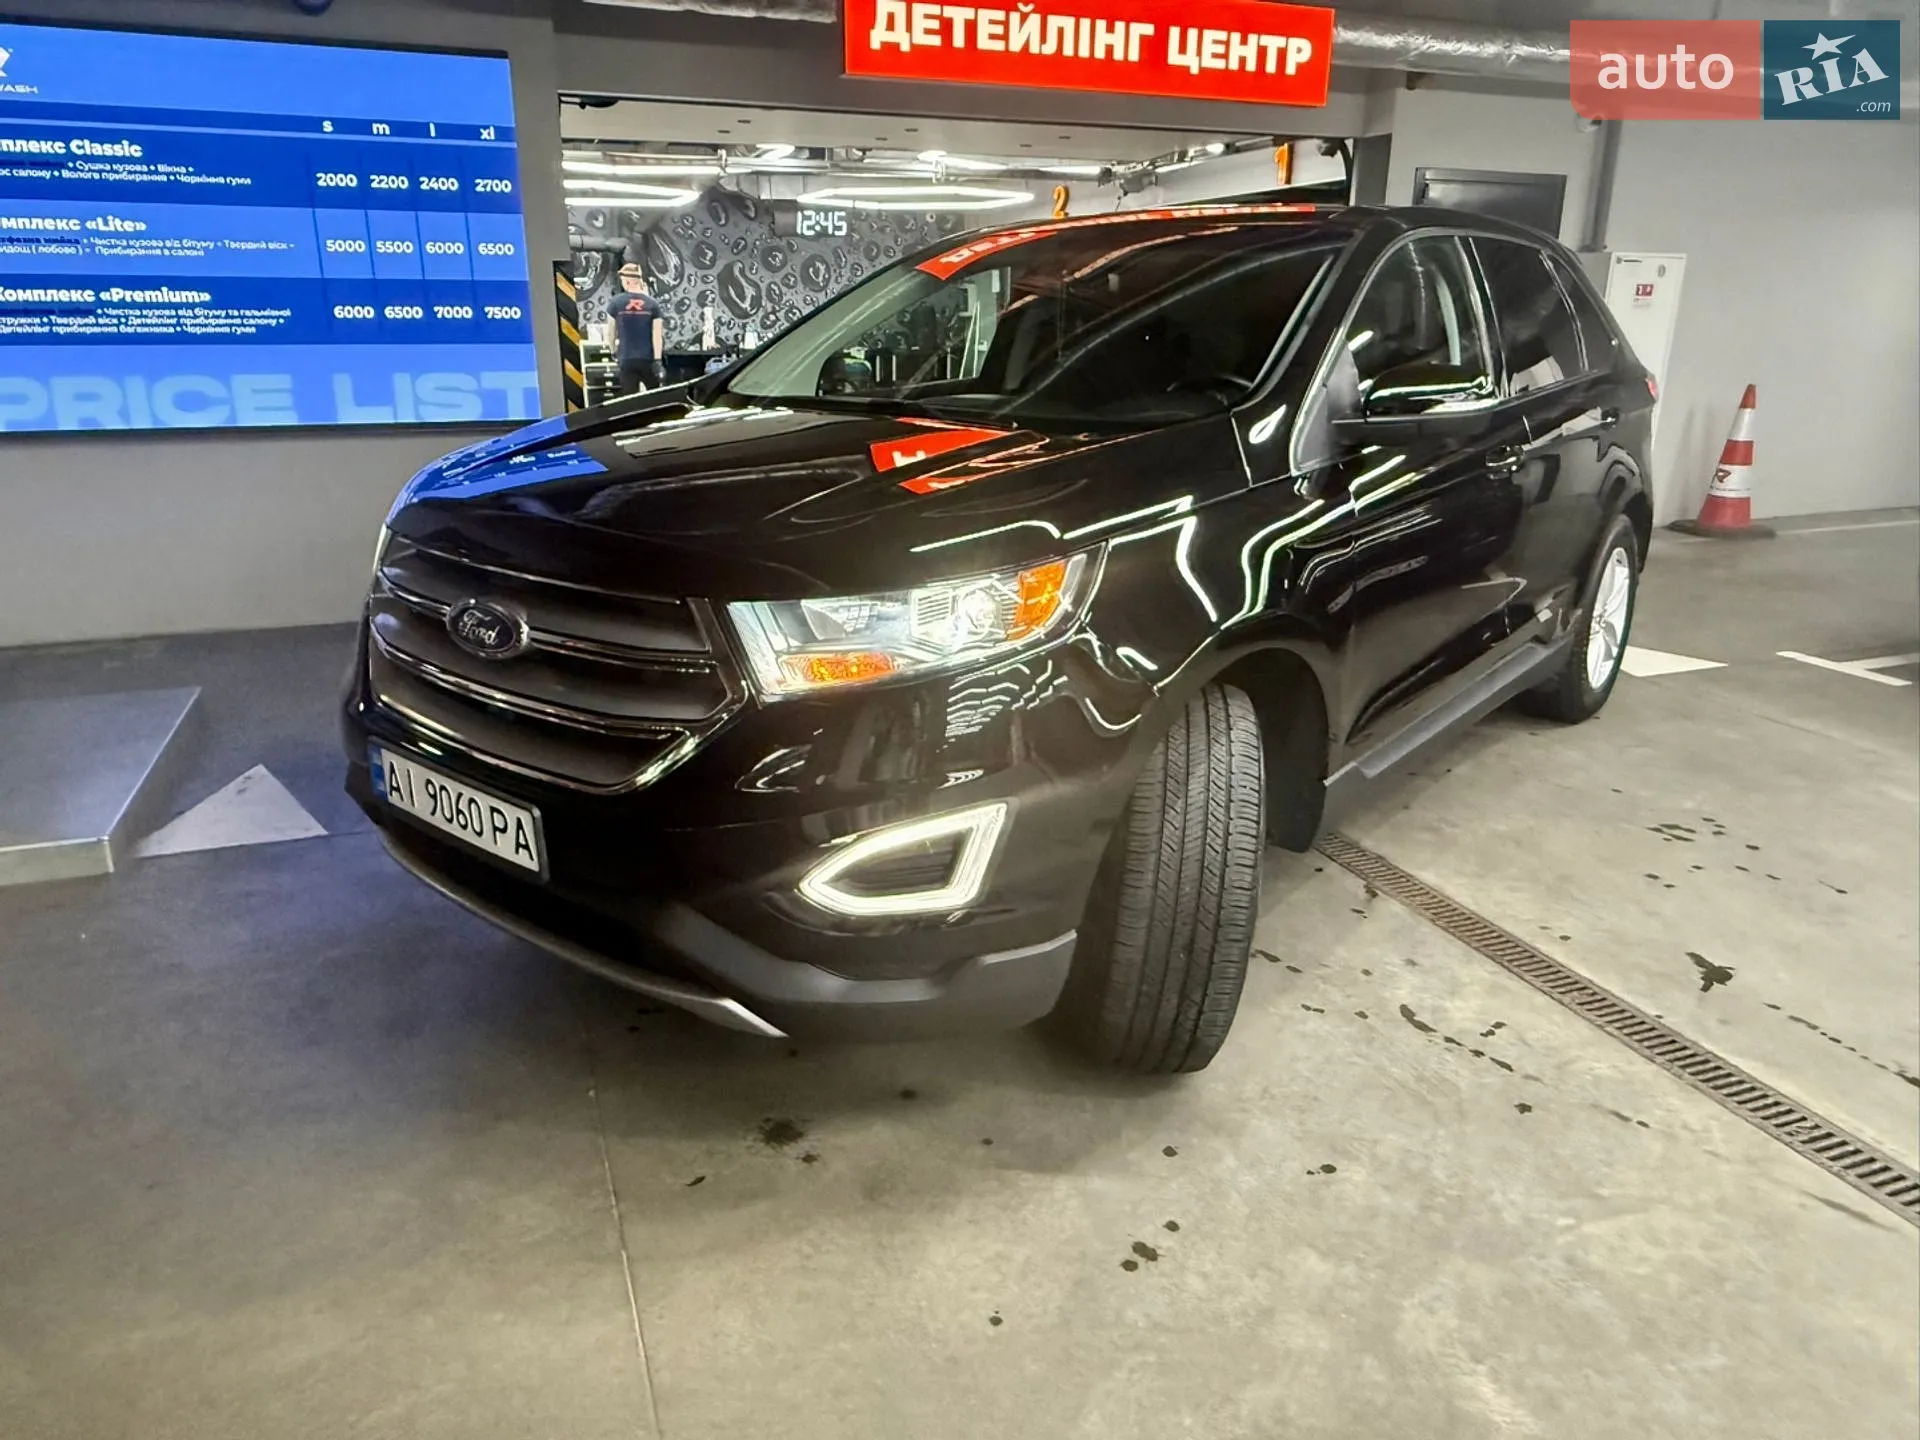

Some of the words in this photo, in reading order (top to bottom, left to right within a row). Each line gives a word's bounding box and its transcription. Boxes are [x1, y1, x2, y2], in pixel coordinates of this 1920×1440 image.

[869, 0, 1154, 62] ДЕТЕЙЛІНГ
[1166, 26, 1312, 76] ЦЕНТР
[0, 84, 38, 94] ASH
[372, 122, 390, 135] m
[480, 126, 495, 140] xl
[0, 139, 67, 154] плекс
[69, 139, 143, 157] Classic
[316, 172, 358, 187] 2000
[369, 174, 409, 189] 2200
[419, 176, 459, 191] 2400
[474, 178, 512, 193] 2700
[1052, 184, 1069, 218] 2
[0, 216, 80, 231] мплекс
[85, 214, 147, 232] «Lite»
[796, 210, 848, 236] 12:45
[325, 239, 366, 253] 5000
[376, 241, 414, 254] 5500
[425, 242, 465, 255] 6000
[477, 243, 515, 256] 6500
[99, 287, 211, 303] «Premium»
[333, 305, 375, 319] 6000
[384, 305, 424, 319] 6500
[433, 306, 473, 319] 7000
[484, 306, 522, 321] 7500
[0, 374, 298, 431] PRICE
[332, 371, 539, 422] LIST
[458, 608, 500, 646] Ford
[388, 760, 416, 808] AI
[424, 777, 484, 838] 9060
[489, 805, 535, 862] PA
